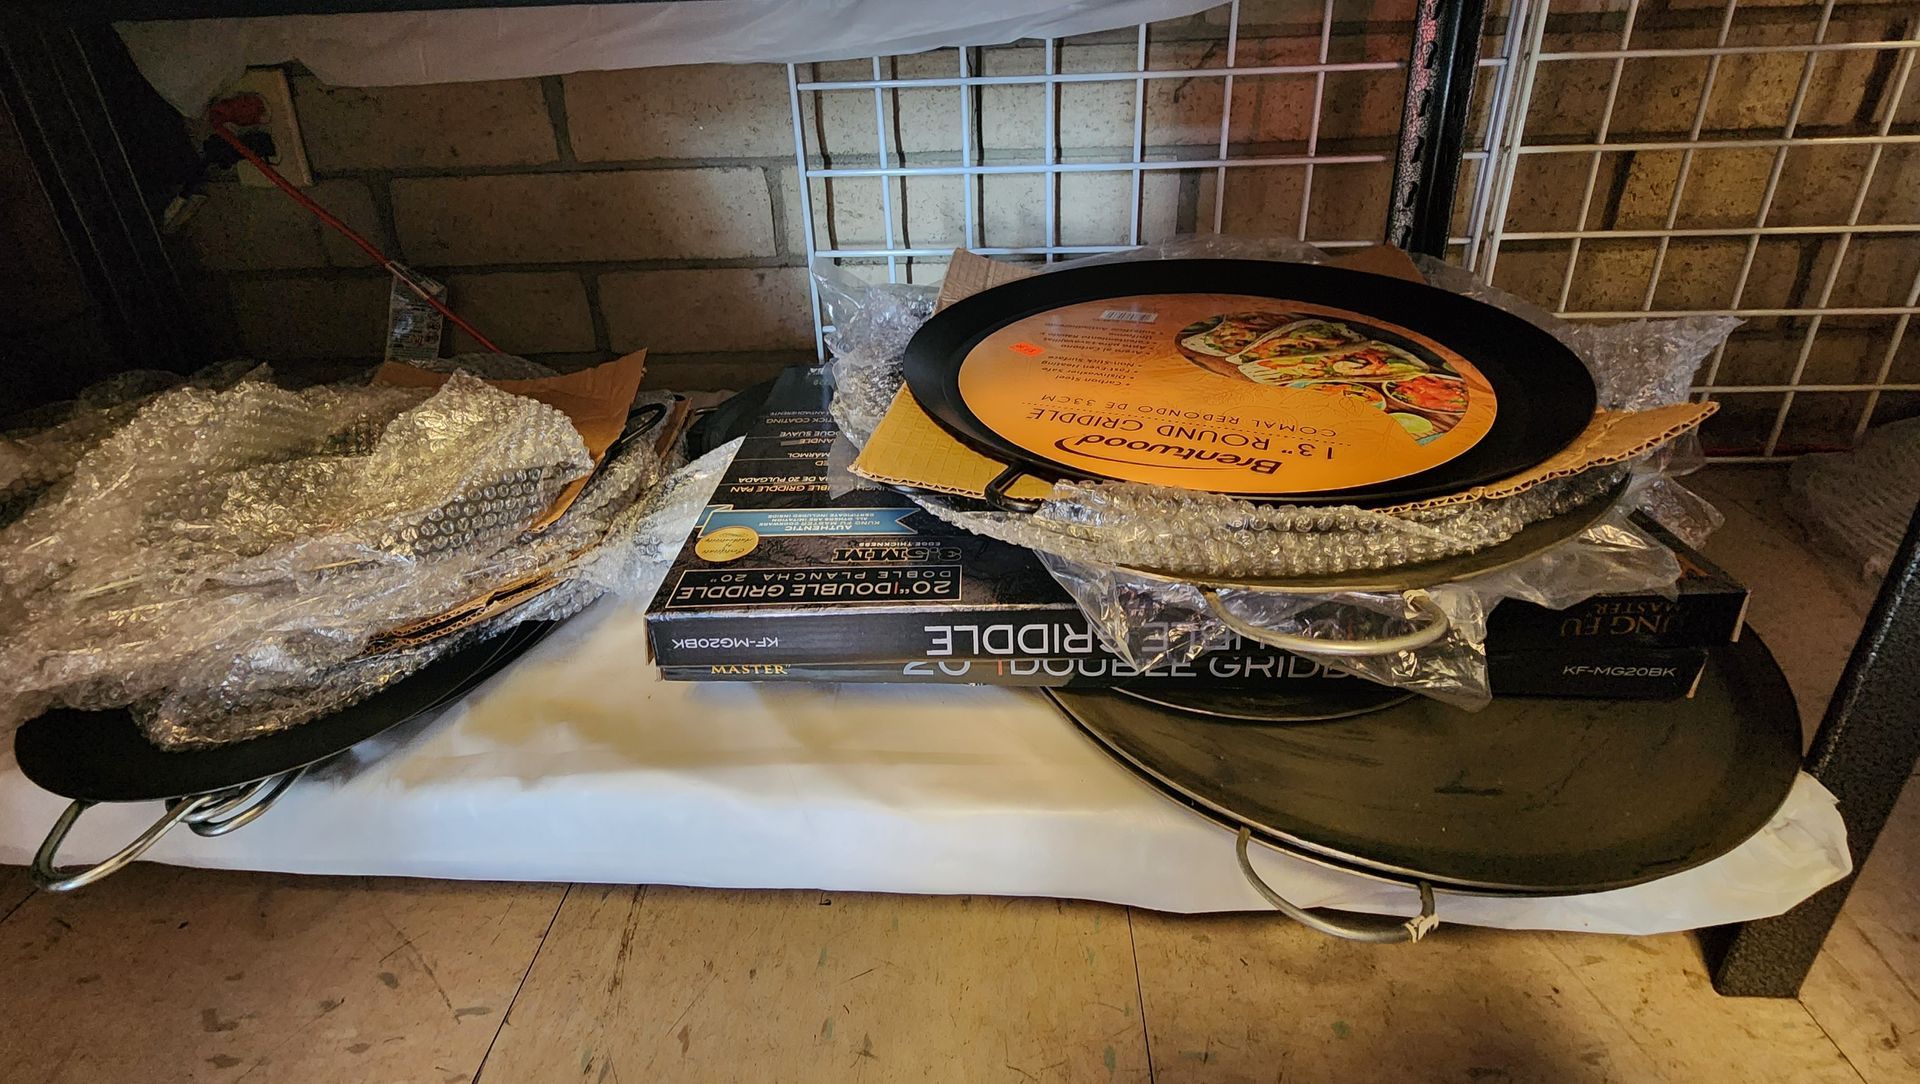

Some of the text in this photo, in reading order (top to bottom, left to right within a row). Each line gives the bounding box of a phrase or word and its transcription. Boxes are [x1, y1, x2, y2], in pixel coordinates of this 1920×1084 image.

[1026, 408, 1144, 432] GRIDDLE
[1041, 394, 1337, 438] COMAL REDONDO DE 33CM
[799, 437, 836, 445] ANDLE
[1156, 424, 1271, 451] ROUND
[1073, 434, 1283, 475] Brentwood
[755, 485, 806, 493] GRIDDLE
[784, 524, 853, 532] AUTHENTIC
[762, 572, 867, 582] PLANCHA
[877, 570, 951, 579] DOBLE
[675, 584, 786, 600] GRIDDLE
[671, 637, 779, 650] KF-MG20BK
[1562, 665, 1677, 678] KF-MG20BK
